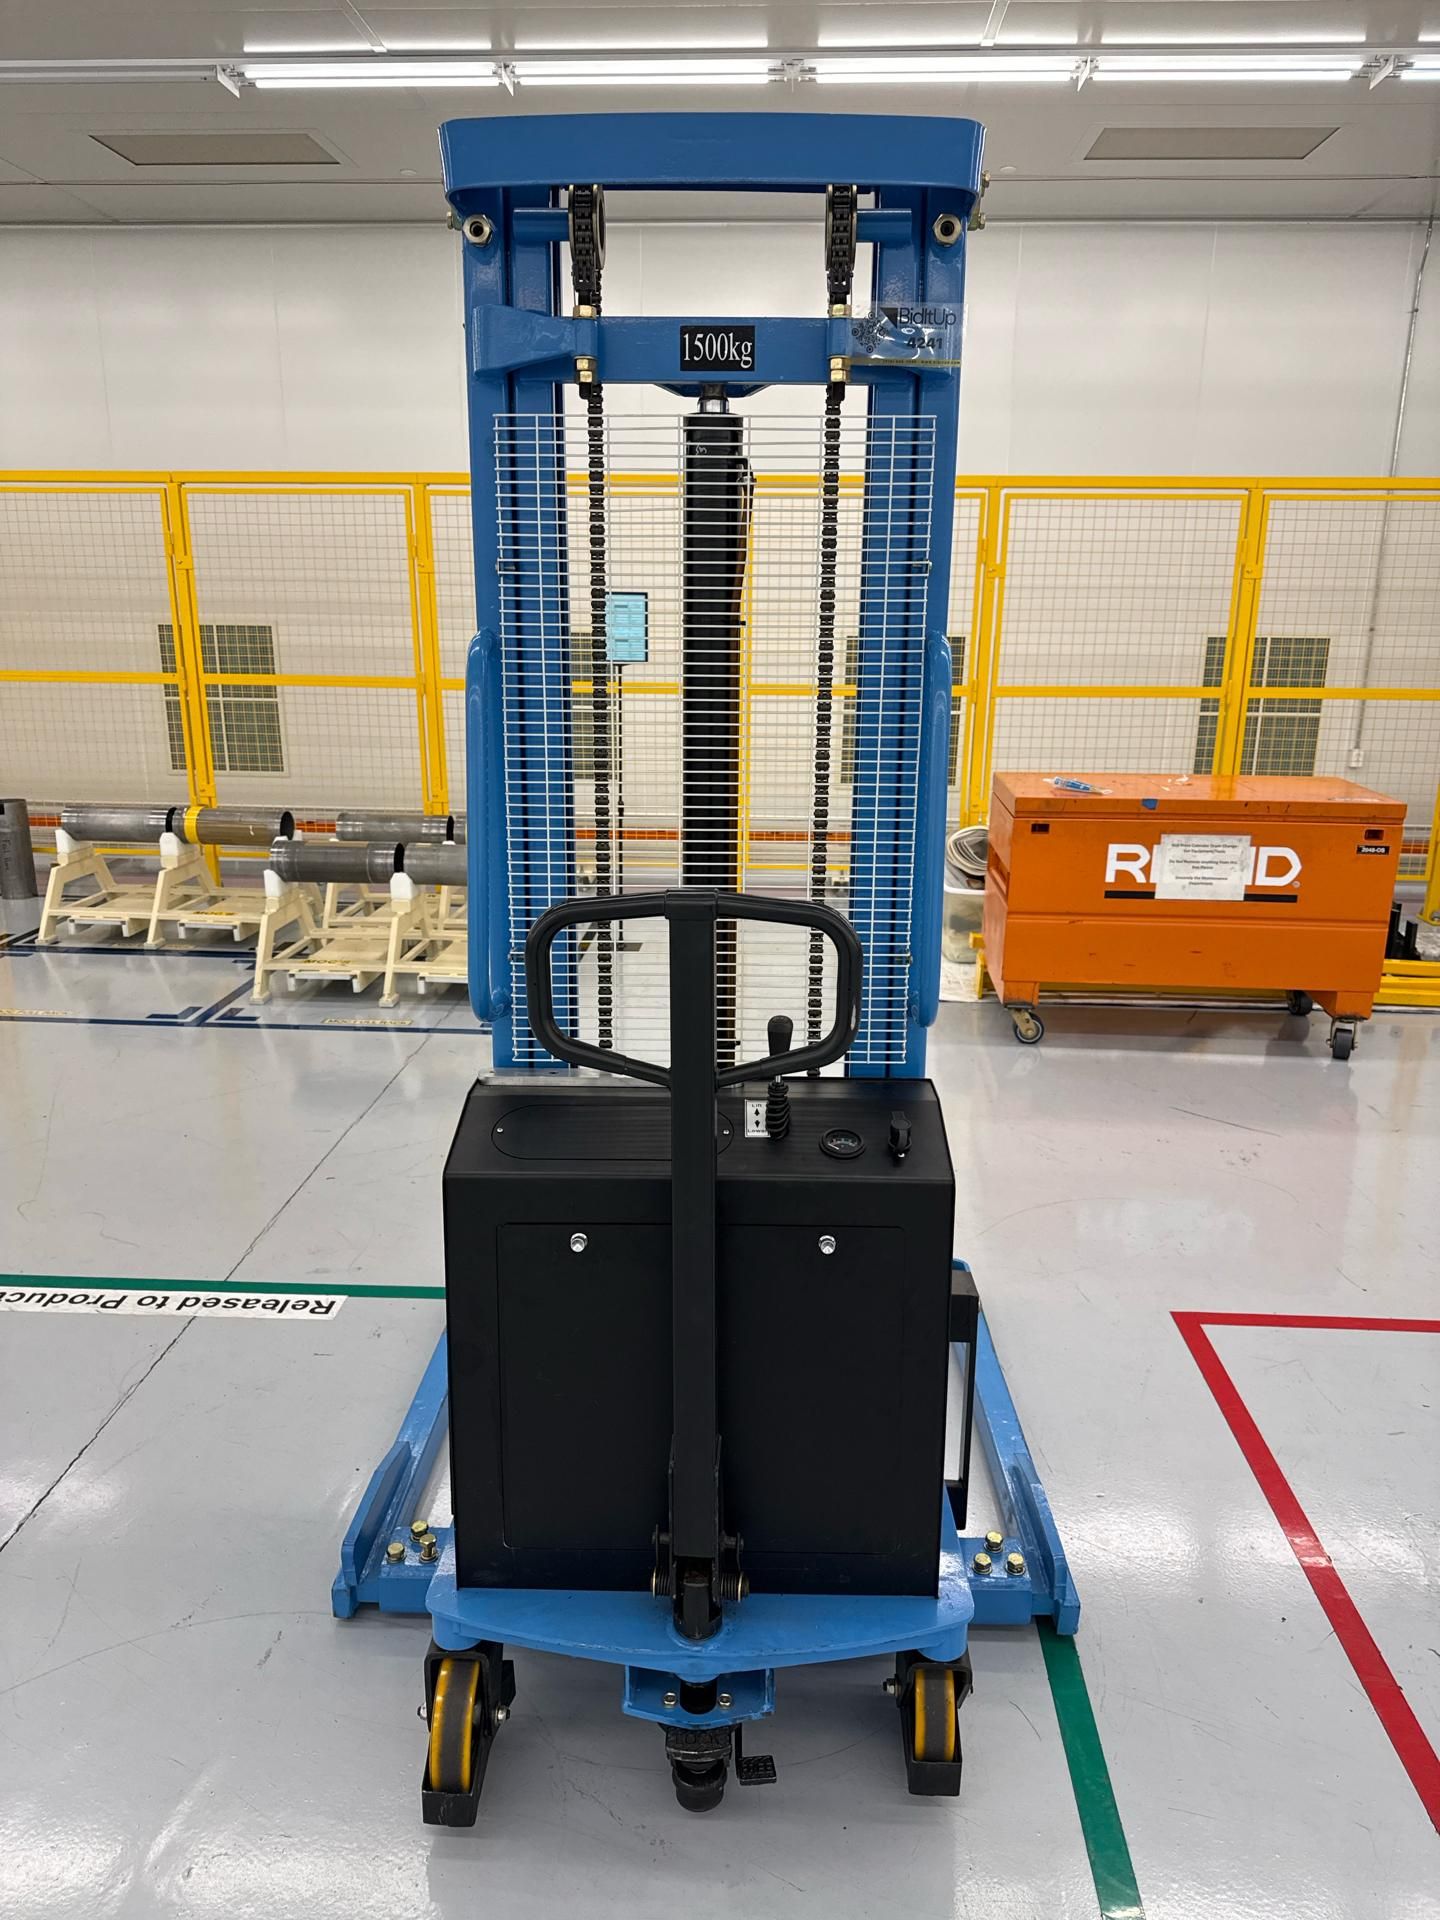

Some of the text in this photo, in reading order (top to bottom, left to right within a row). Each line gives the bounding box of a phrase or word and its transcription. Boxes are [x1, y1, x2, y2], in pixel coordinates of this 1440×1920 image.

[900, 307, 957, 329] BidItUp
[682, 332, 753, 368] 1500kg
[907, 337, 943, 348] 4241
[1105, 843, 1302, 887] RIID
[137, 1293, 167, 1309] to
[176, 1296, 337, 1315] Released
